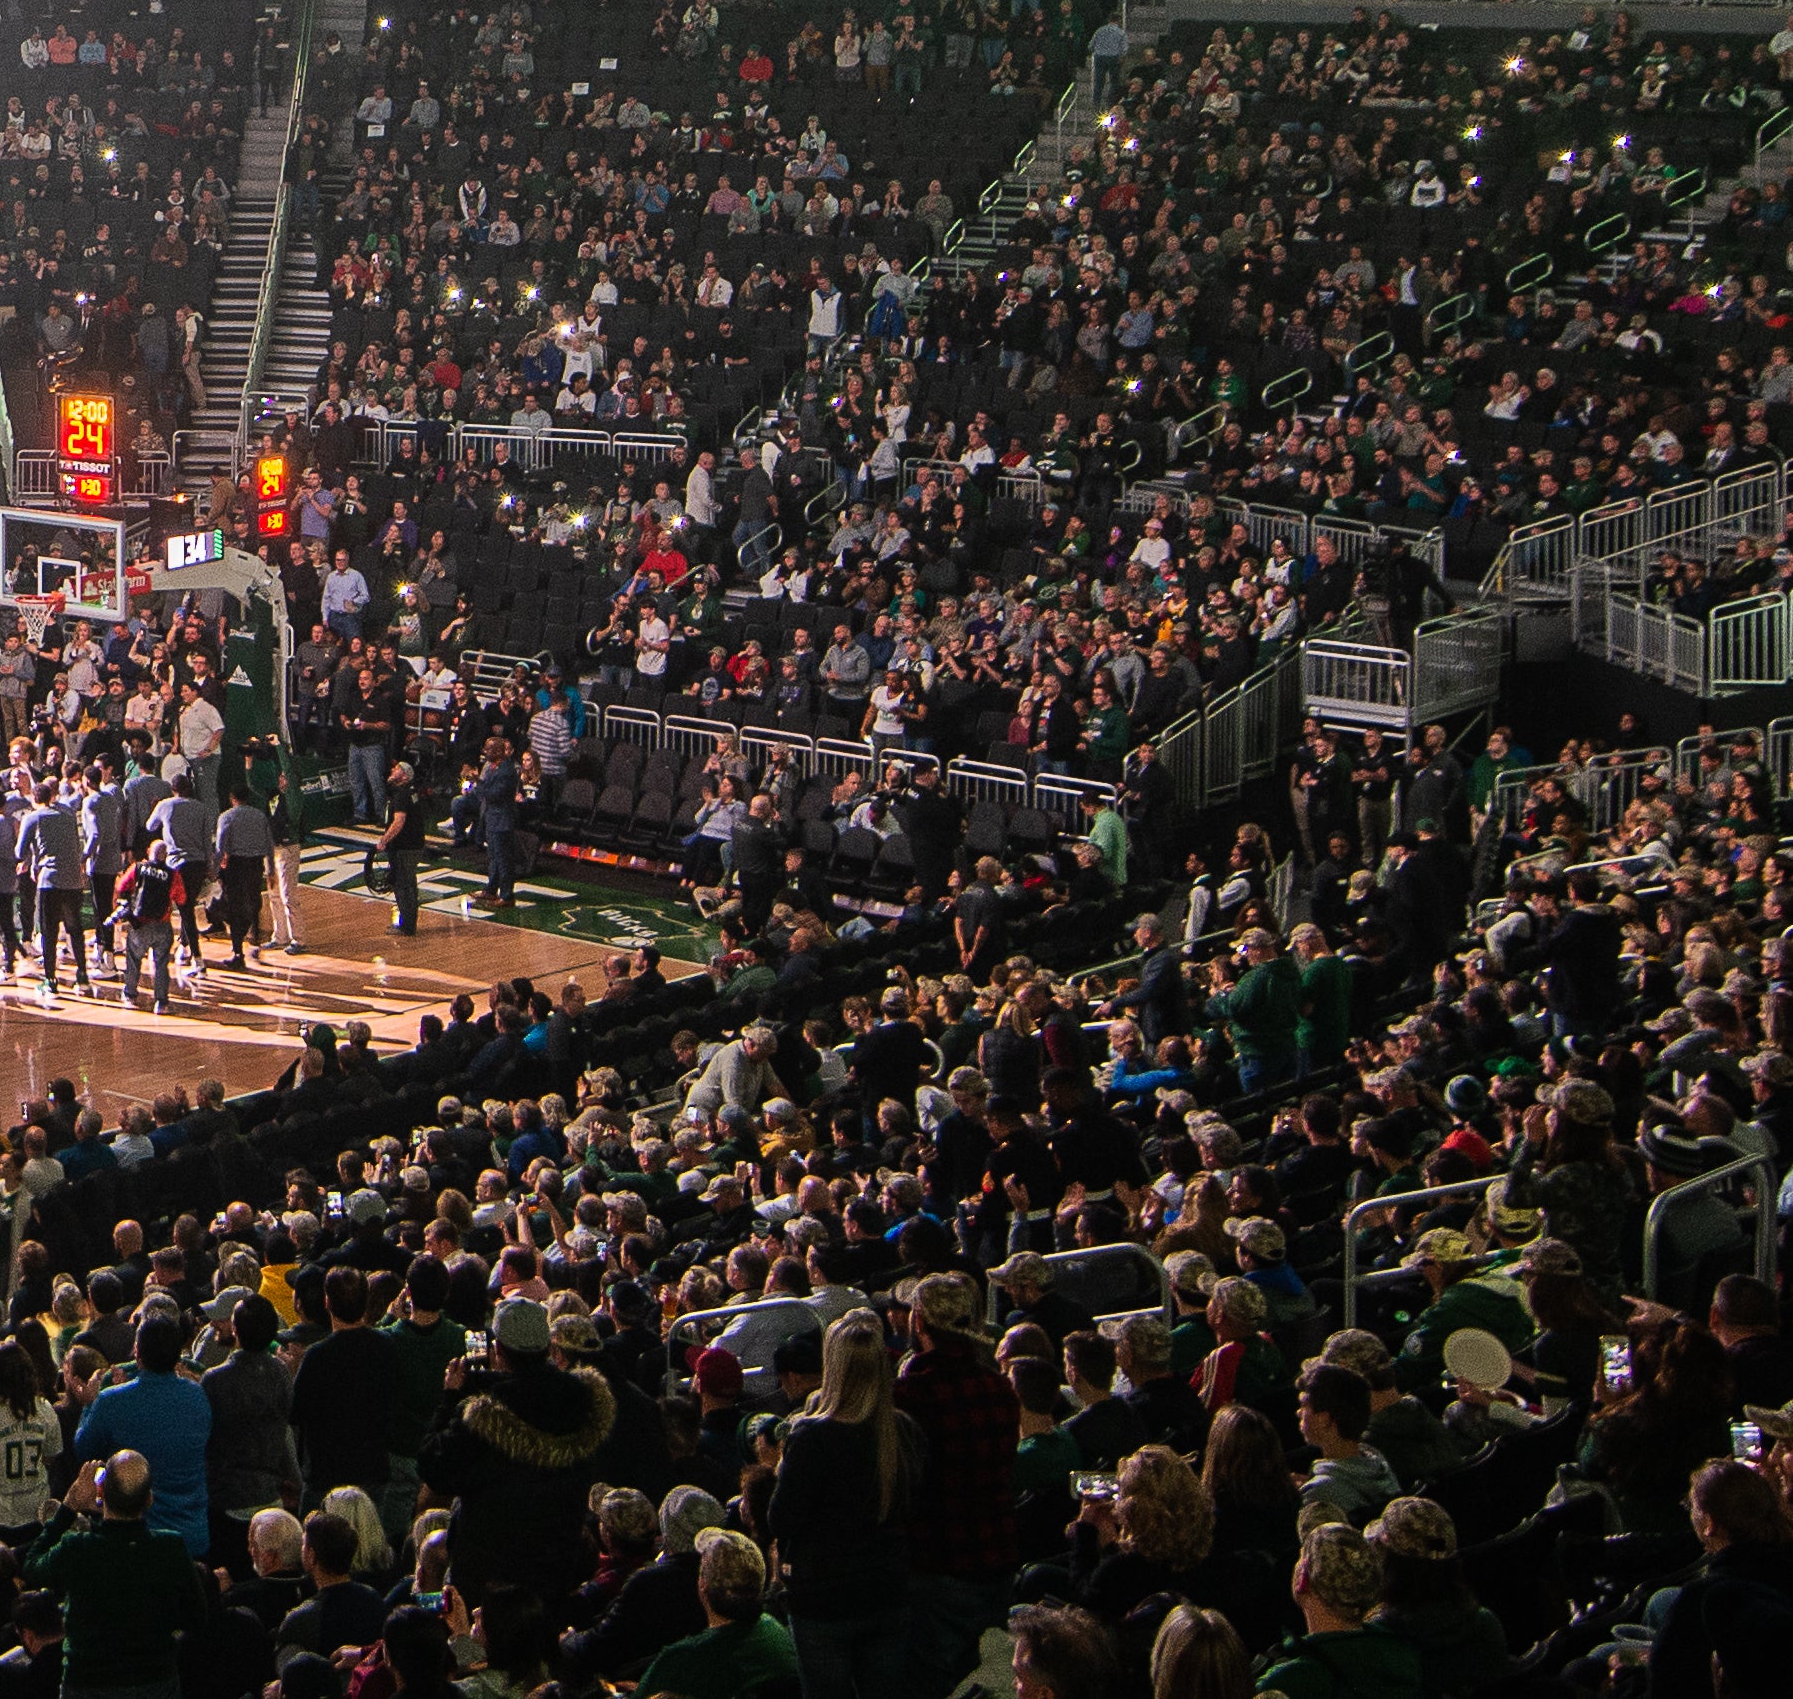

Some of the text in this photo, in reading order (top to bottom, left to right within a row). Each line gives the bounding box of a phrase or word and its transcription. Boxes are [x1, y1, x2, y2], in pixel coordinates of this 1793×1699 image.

[68, 420, 103, 454] 24
[74, 462, 111, 474] TISSOT
[262, 476, 280, 495] 24
[184, 532, 207, 565] 34
[5, 1441, 41, 1479] 03
